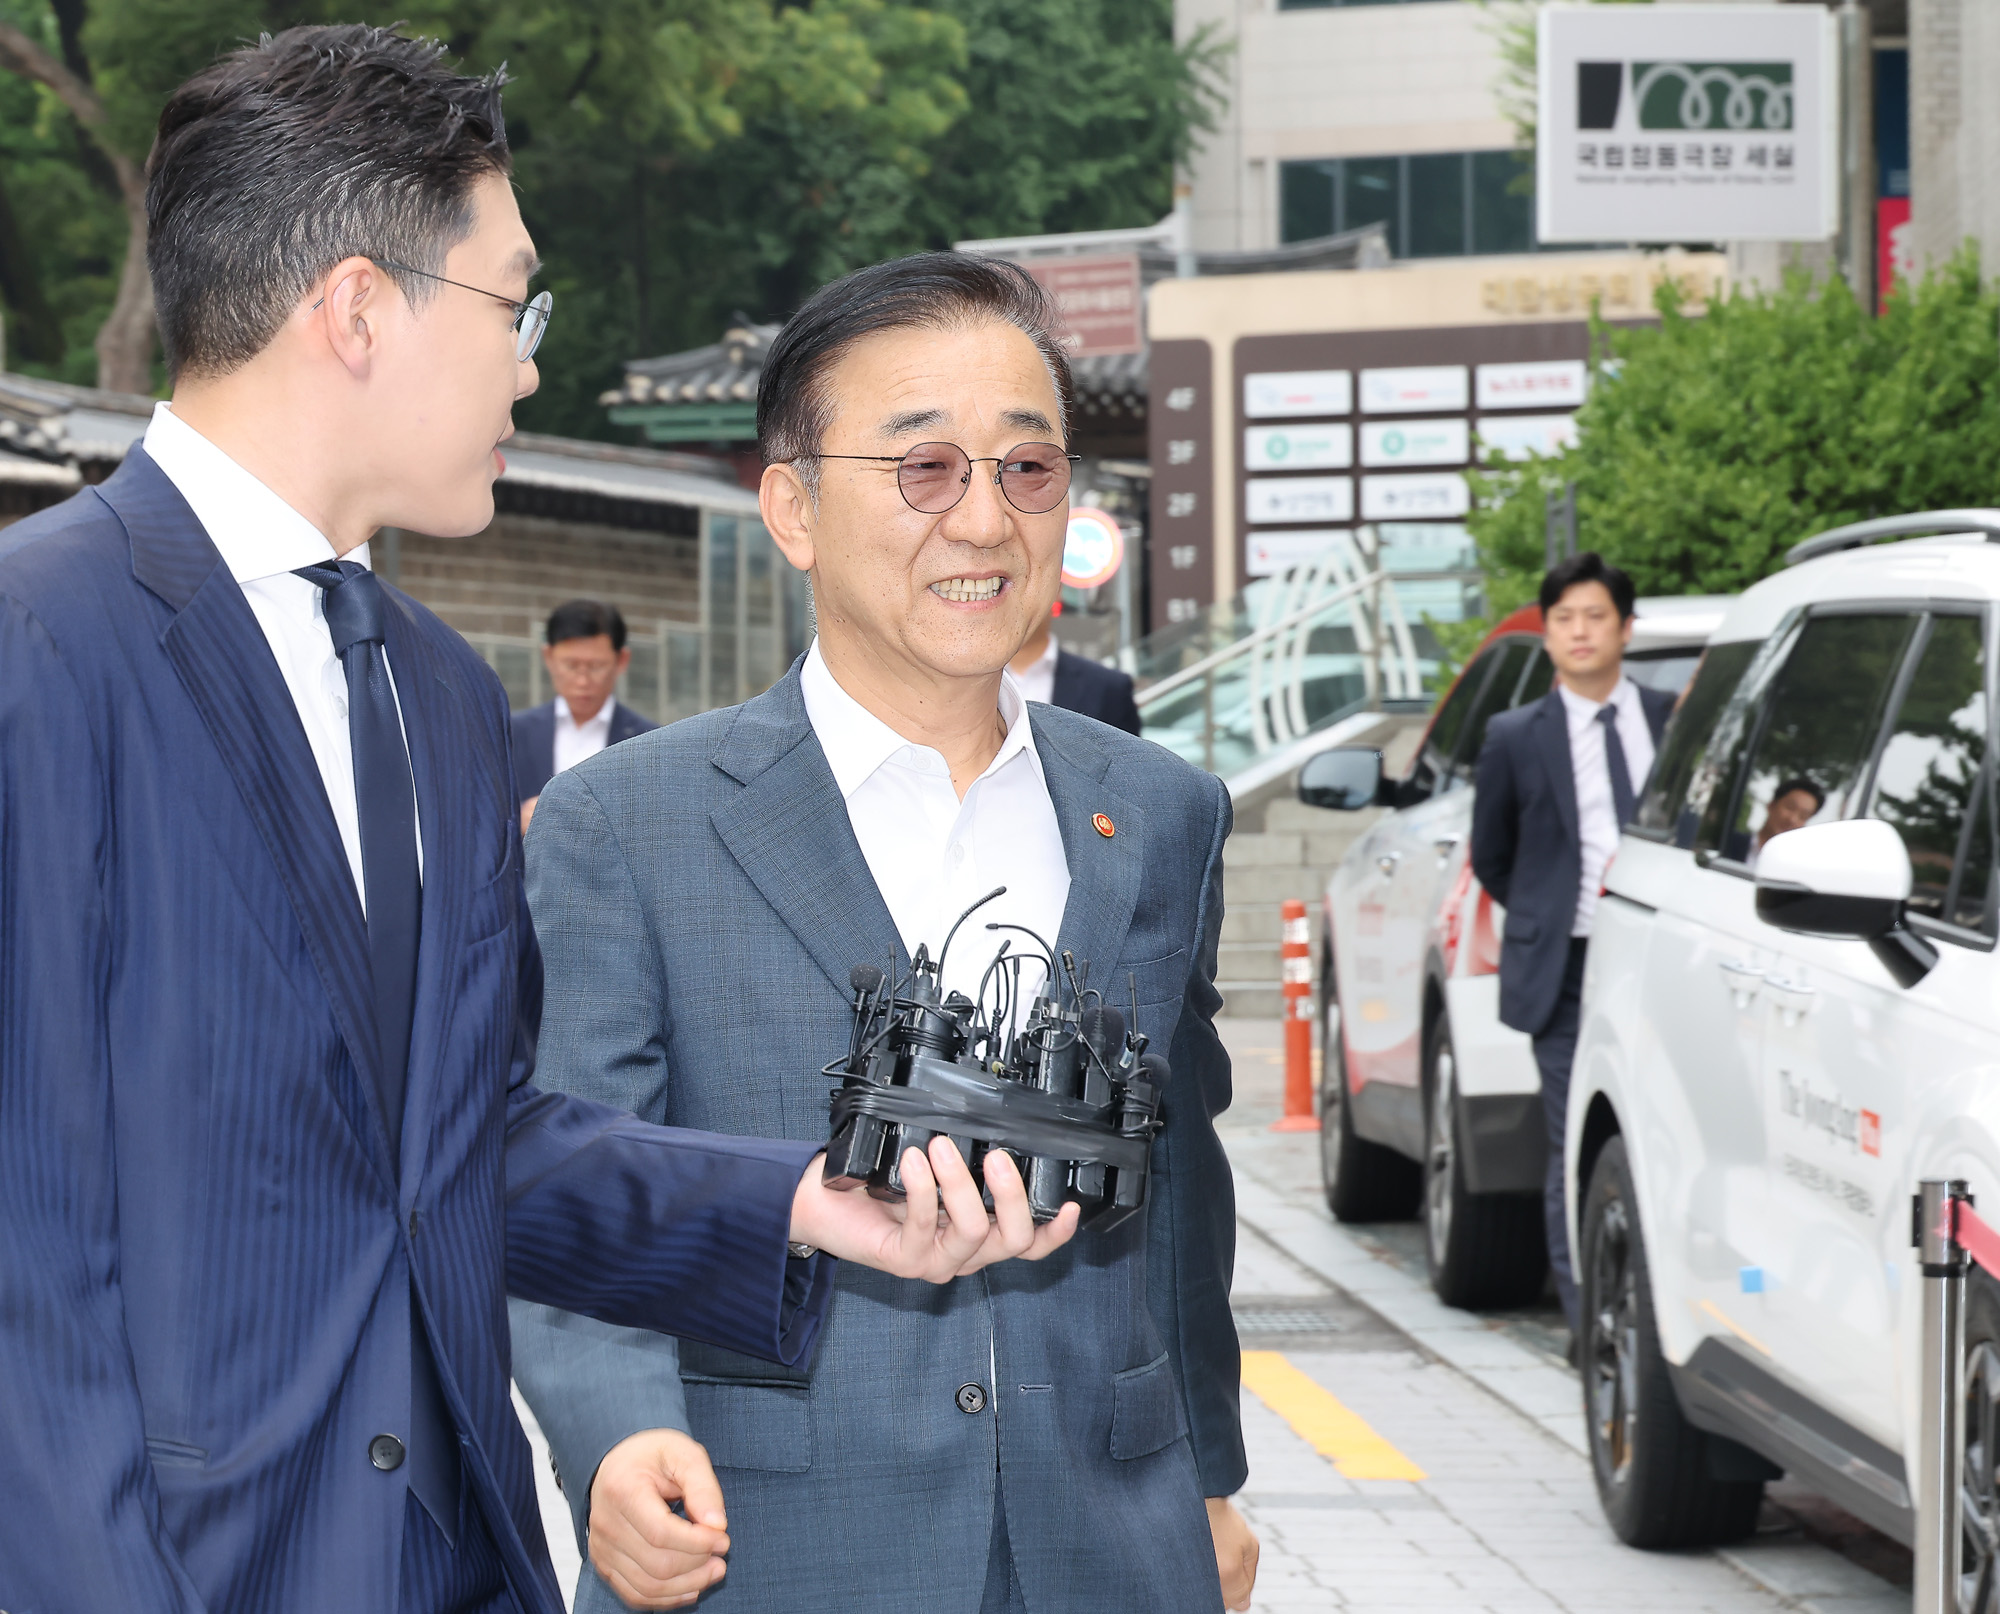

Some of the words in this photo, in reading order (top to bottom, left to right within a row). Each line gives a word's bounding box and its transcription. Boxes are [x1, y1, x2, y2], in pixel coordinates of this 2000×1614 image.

[1166, 387, 1196, 411] 4F
[1167, 440, 1196, 465] 3F
[1167, 493, 1197, 517] 2F
[1170, 545, 1197, 569] 1F
[1167, 598, 1197, 623] B1
